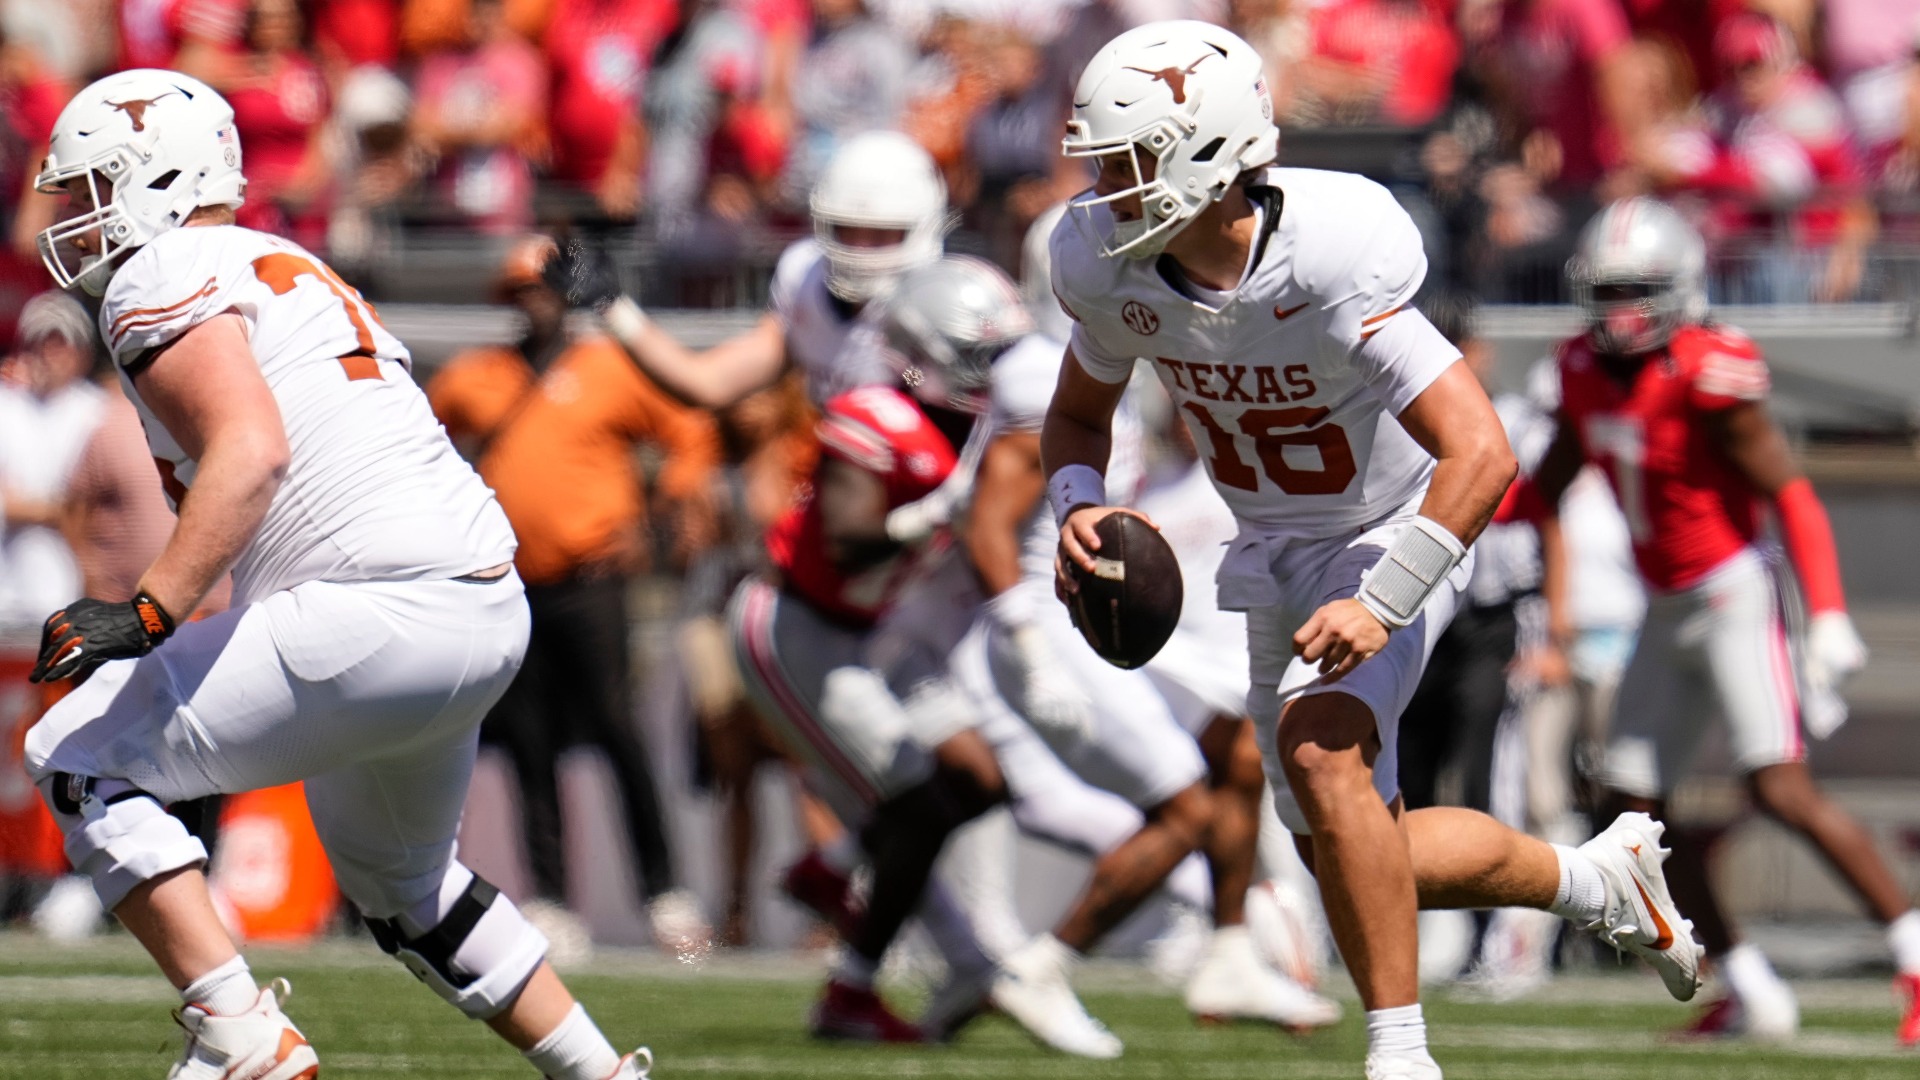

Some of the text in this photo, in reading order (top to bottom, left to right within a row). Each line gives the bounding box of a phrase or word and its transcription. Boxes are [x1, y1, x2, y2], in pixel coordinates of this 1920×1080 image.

[1122, 301, 1159, 335] SEC
[1156, 356, 1317, 403] TEXAS
[1181, 400, 1357, 495] 16
[137, 603, 165, 634] NIKE
